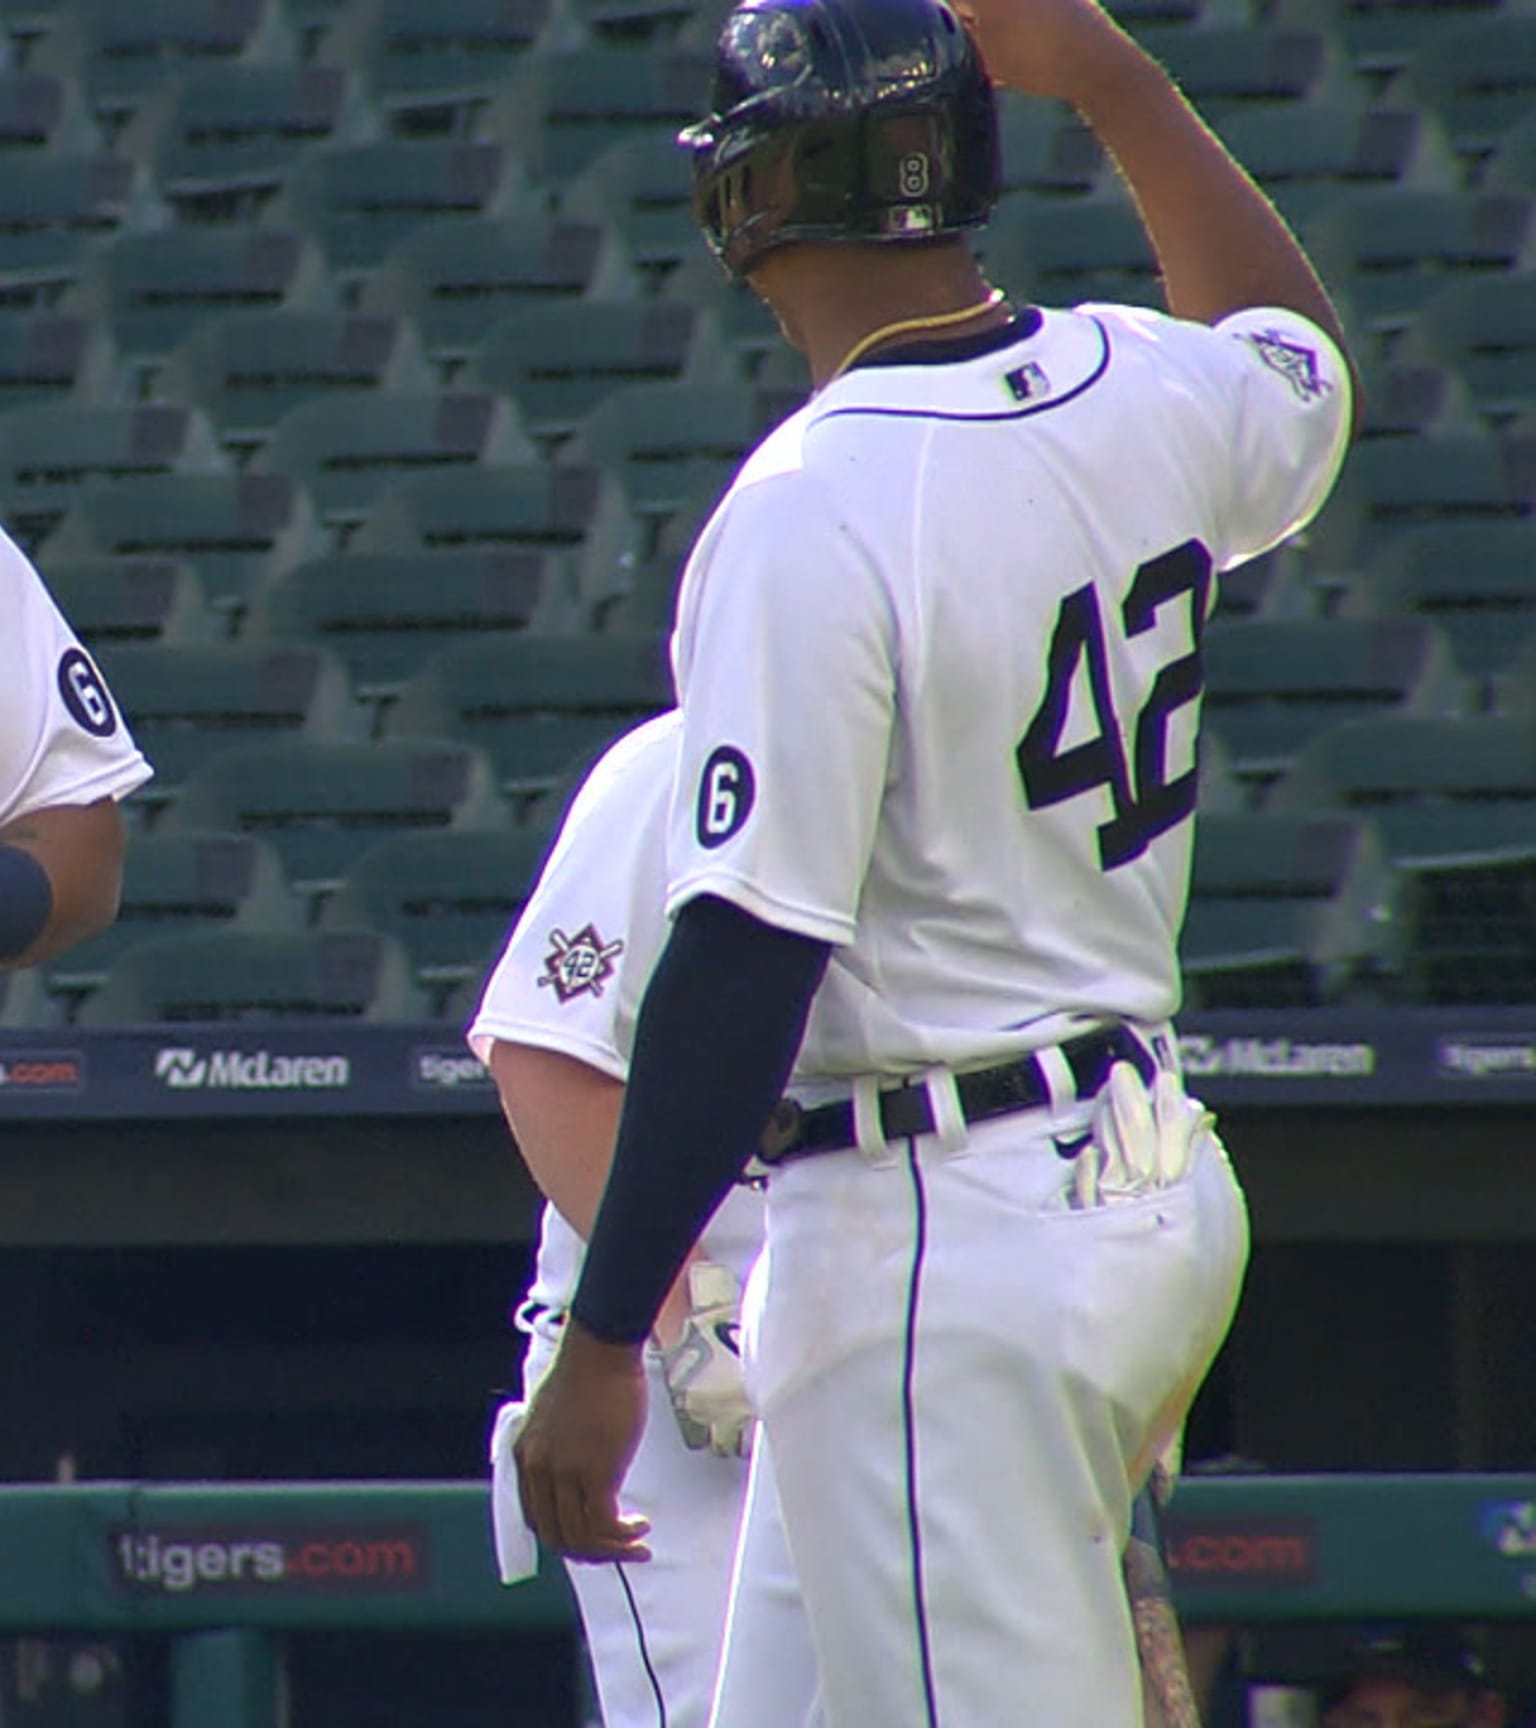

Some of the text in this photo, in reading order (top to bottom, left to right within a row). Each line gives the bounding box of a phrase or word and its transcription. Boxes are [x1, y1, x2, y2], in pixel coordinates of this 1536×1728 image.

[899, 152, 929, 198] 8
[1015, 536, 1214, 873] 42
[706, 762, 739, 834] 6
[563, 949, 596, 982] 42
[207, 1052, 348, 1087] McLaren
[1225, 1037, 1375, 1076] McLaren
[119, 1534, 414, 1591] tigers.com
